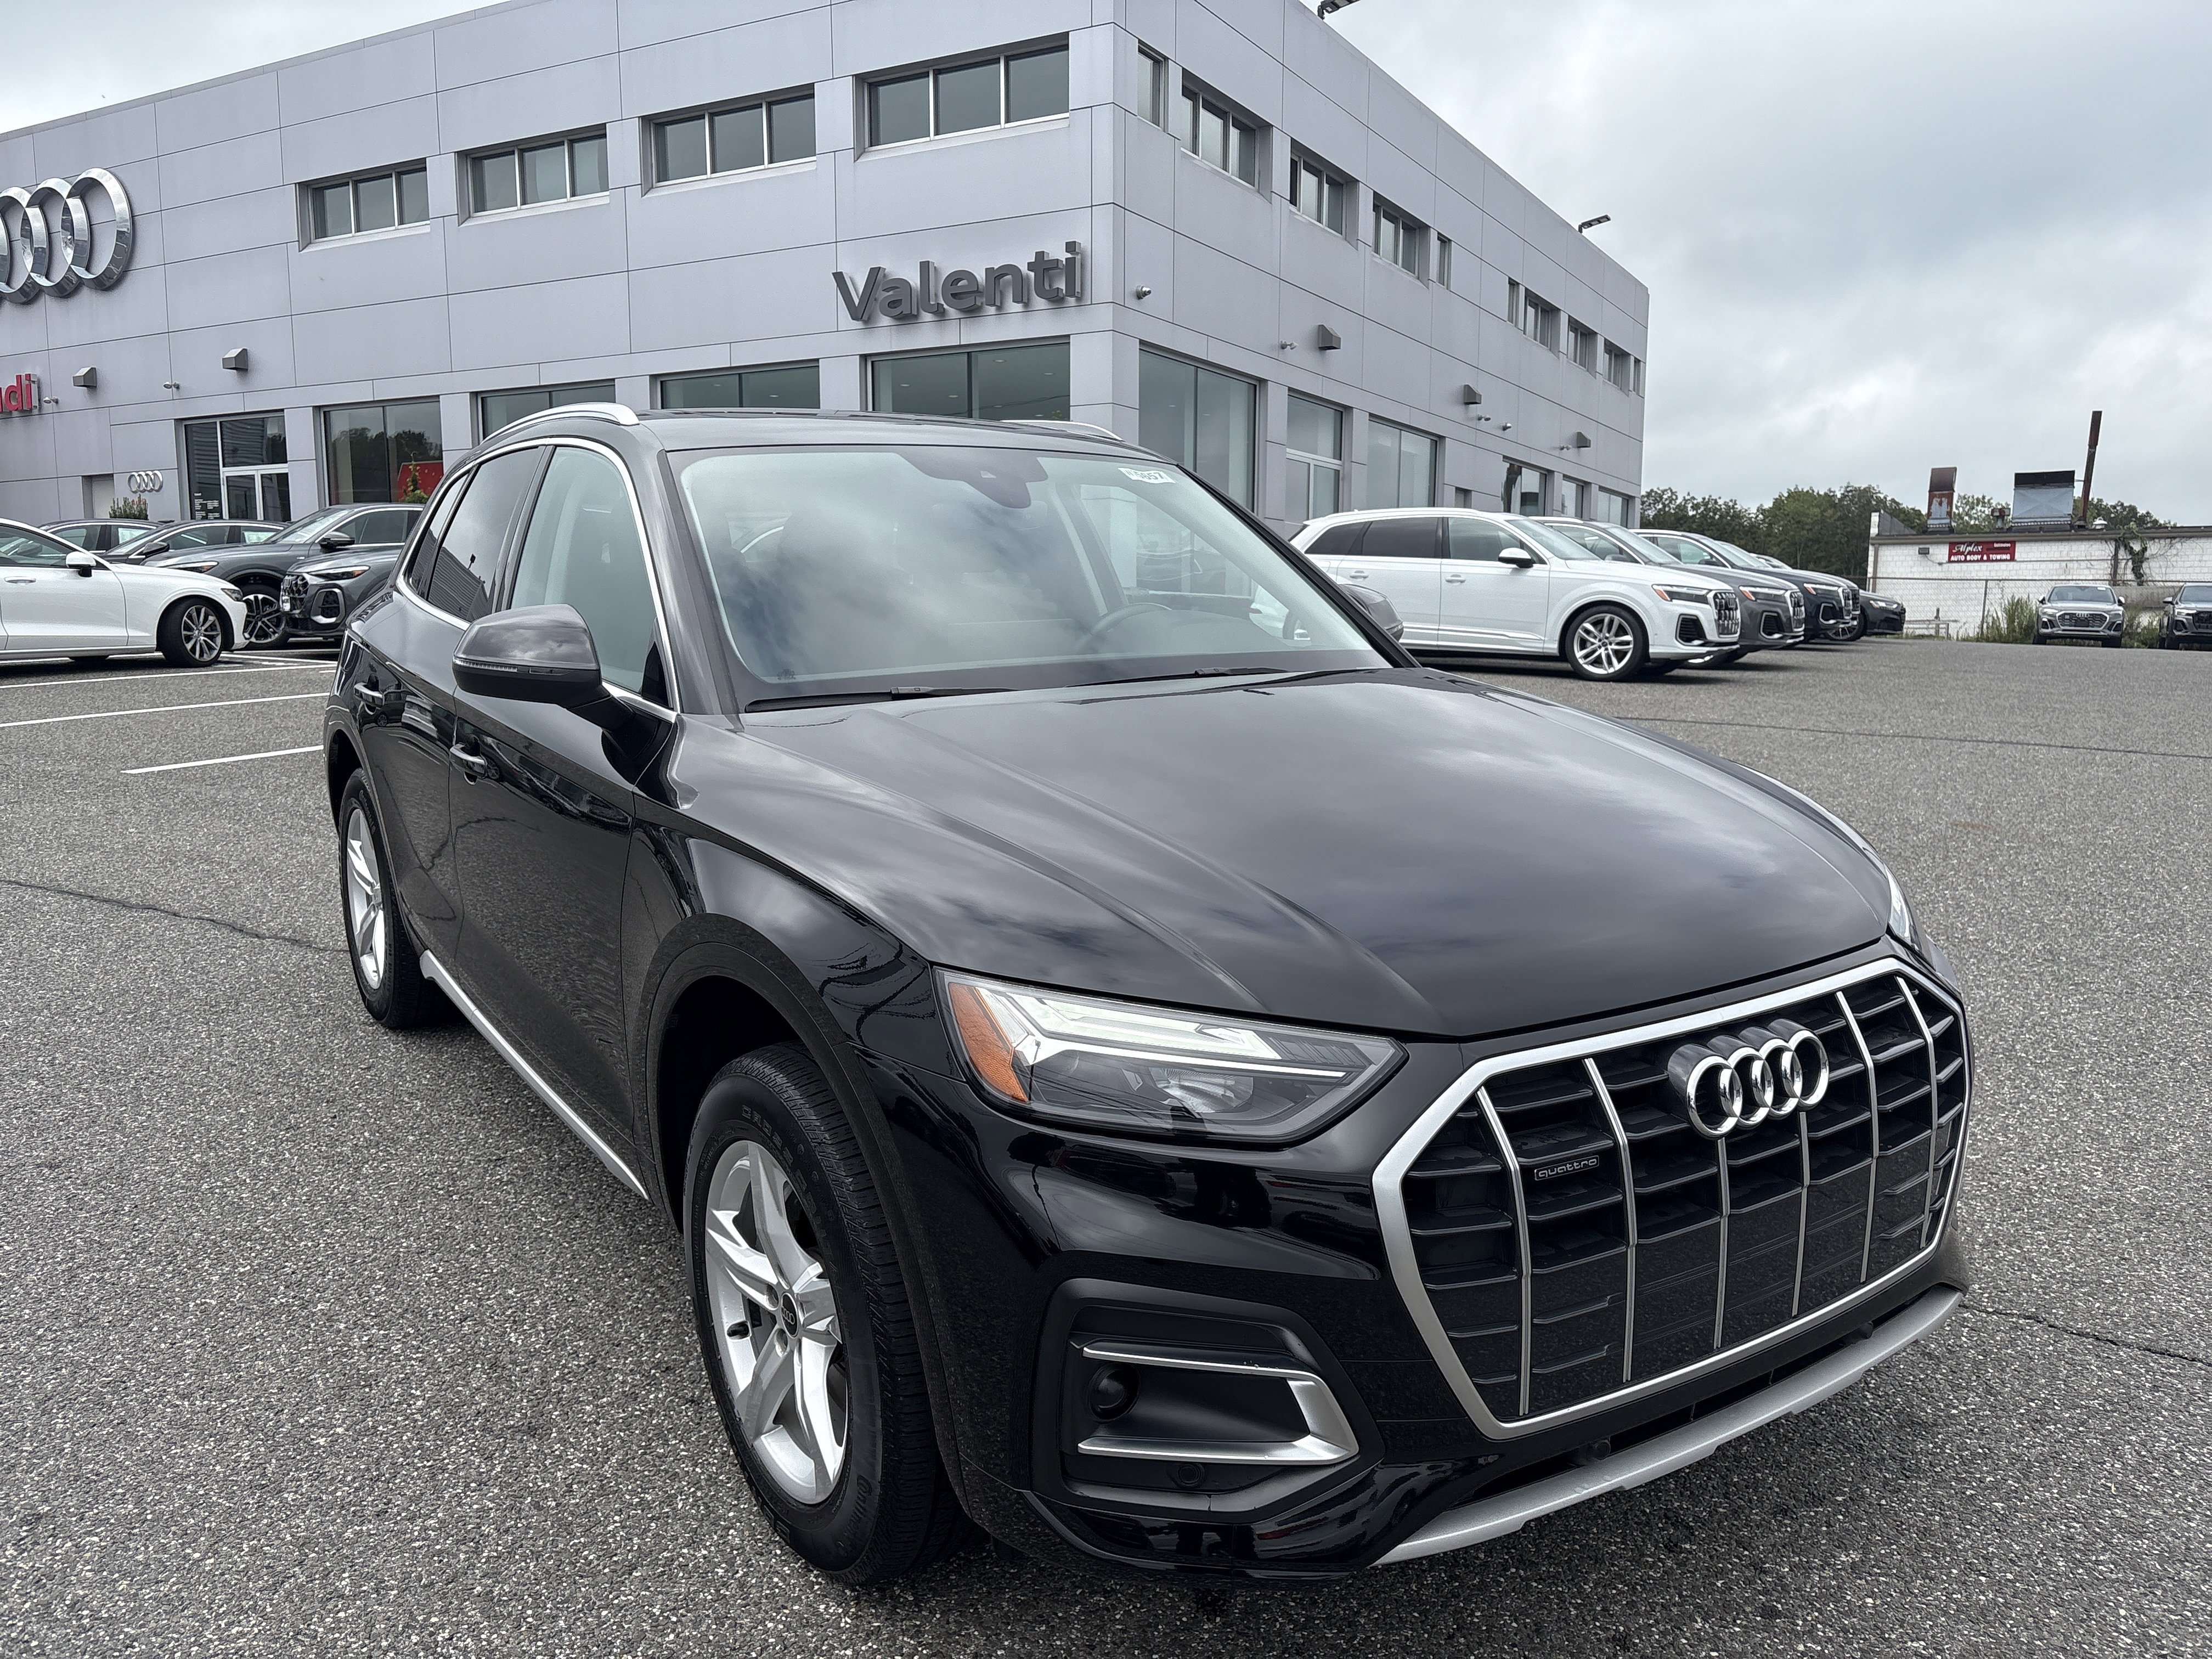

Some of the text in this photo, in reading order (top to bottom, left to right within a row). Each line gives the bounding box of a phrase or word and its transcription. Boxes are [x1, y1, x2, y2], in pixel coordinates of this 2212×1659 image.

[832, 240, 1081, 321] Valenti
[0, 373, 37, 413] di
[1538, 1159, 1597, 1178] quattro
